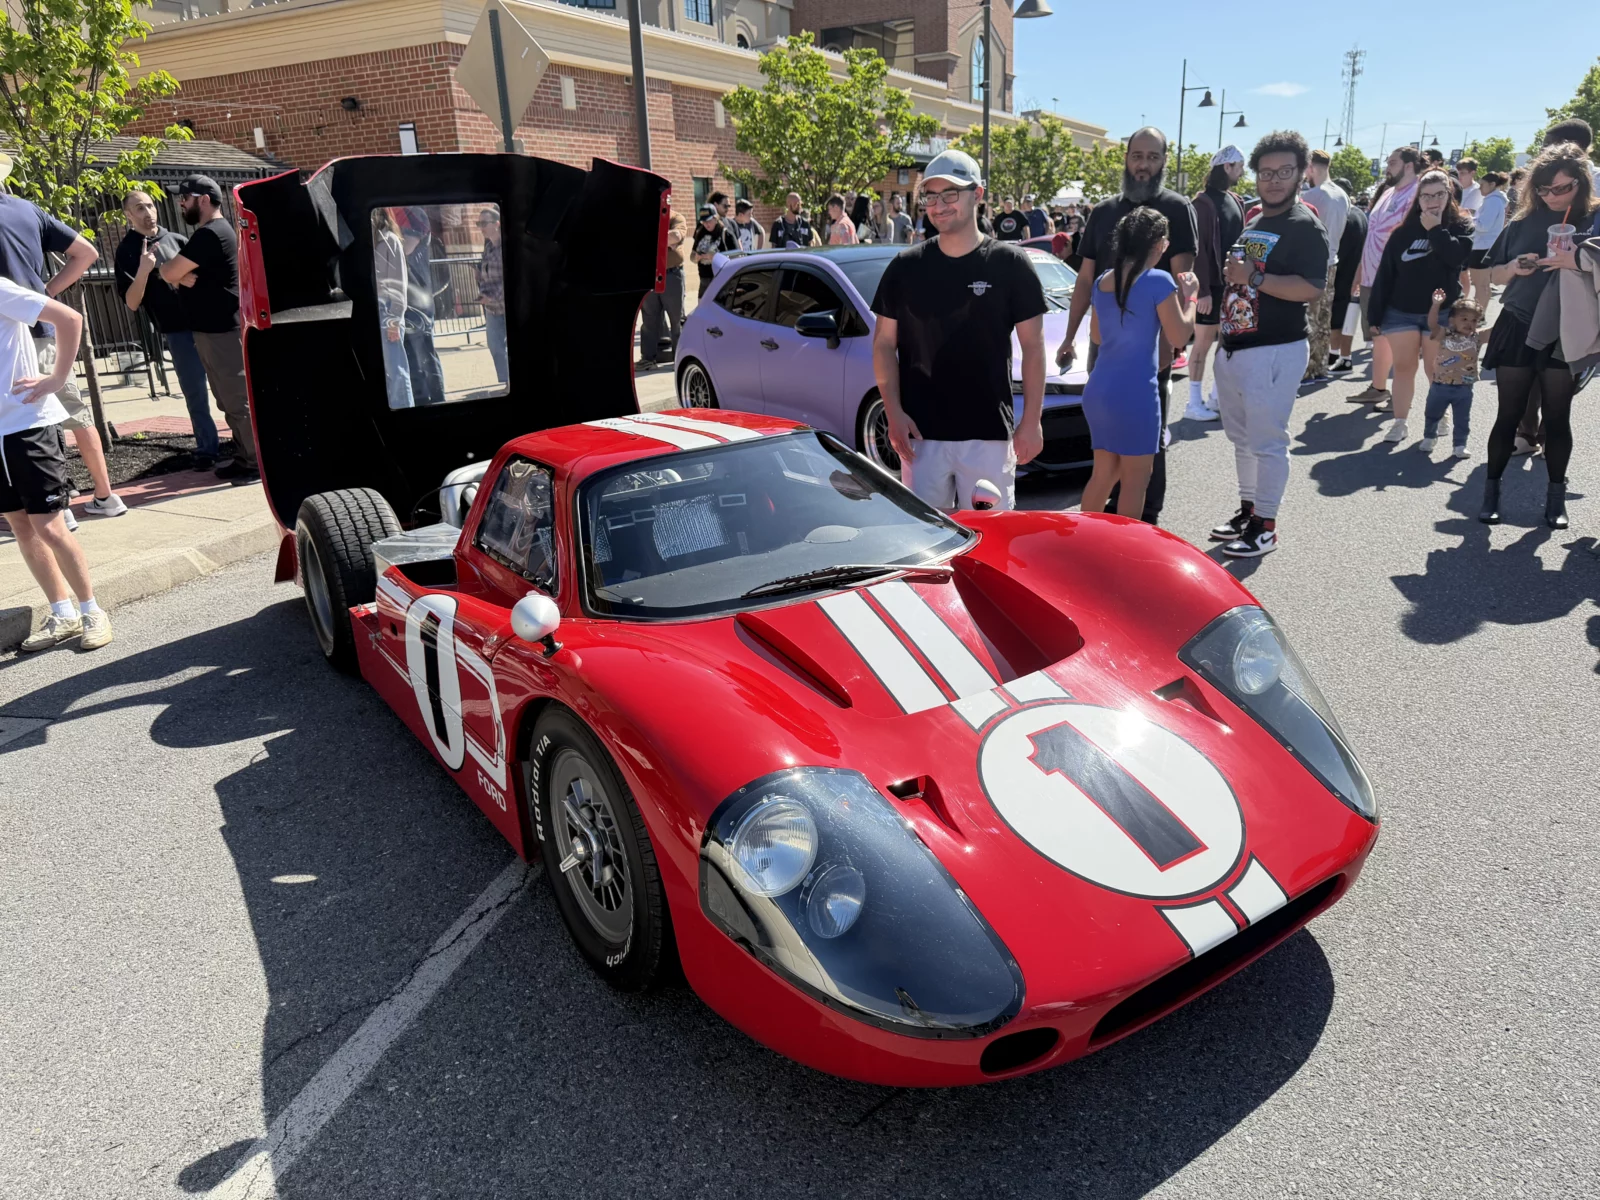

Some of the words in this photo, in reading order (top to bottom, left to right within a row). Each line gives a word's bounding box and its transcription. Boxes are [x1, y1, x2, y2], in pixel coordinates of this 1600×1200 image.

[420, 611, 452, 751] 1
[536, 734, 552, 757] T/A
[477, 769, 507, 812] FORD
[531, 759, 546, 842] Radial
[1026, 720, 1210, 872] 1
